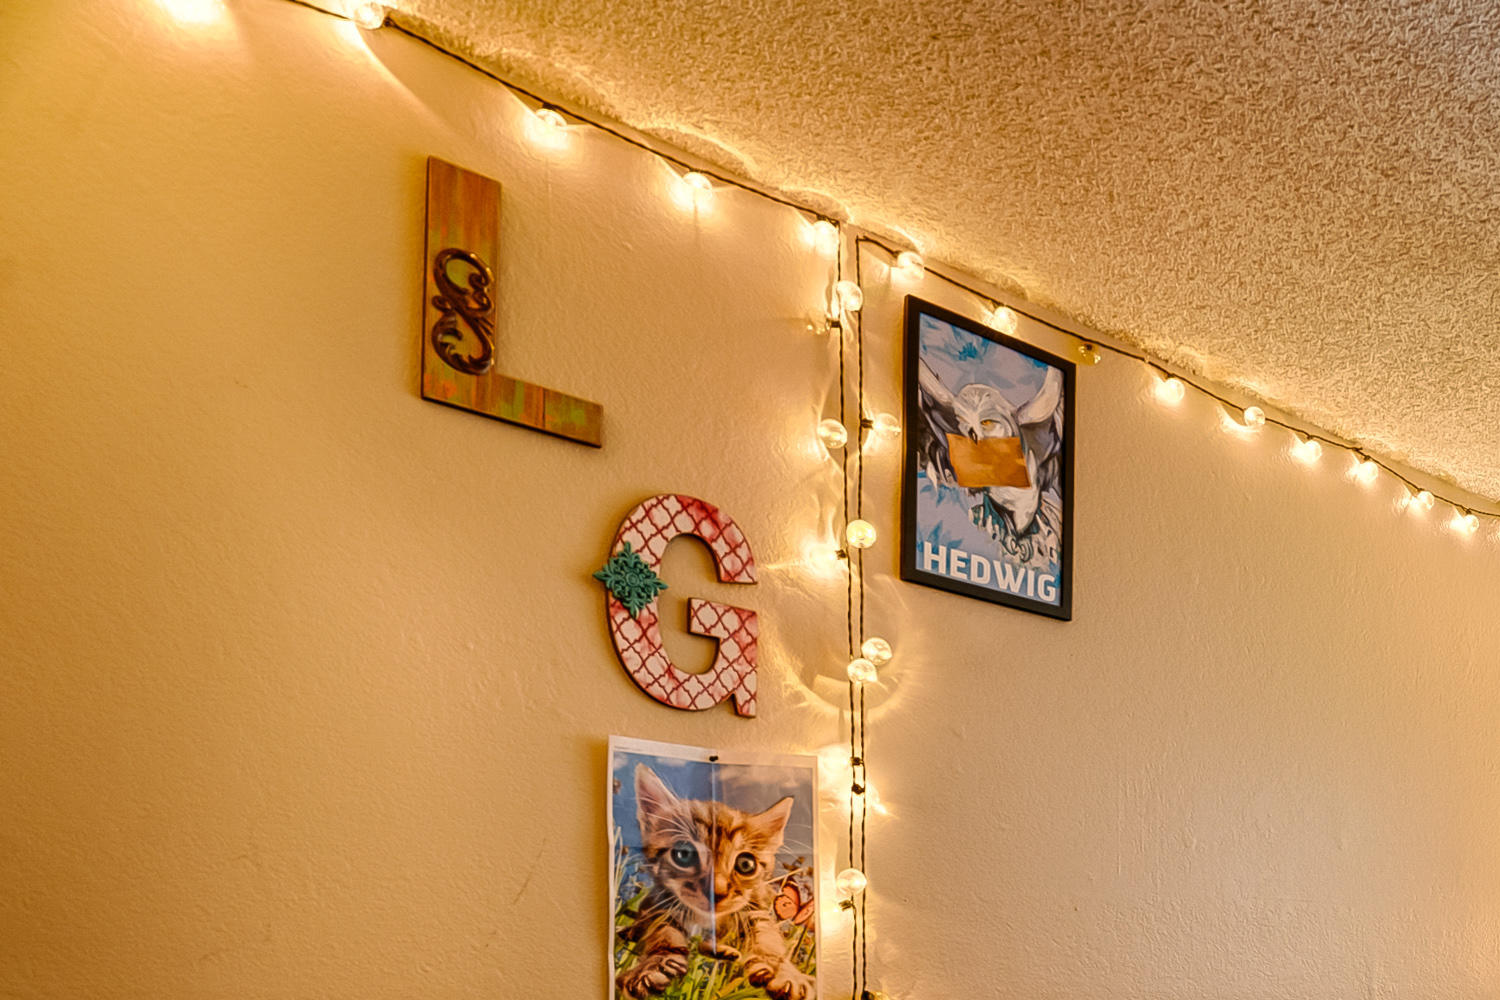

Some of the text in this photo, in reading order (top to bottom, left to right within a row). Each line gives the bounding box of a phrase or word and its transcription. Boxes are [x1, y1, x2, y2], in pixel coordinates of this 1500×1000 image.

[421, 155, 602, 448] L
[605, 493, 758, 718] G
[923, 541, 1057, 602] HEDWIG
